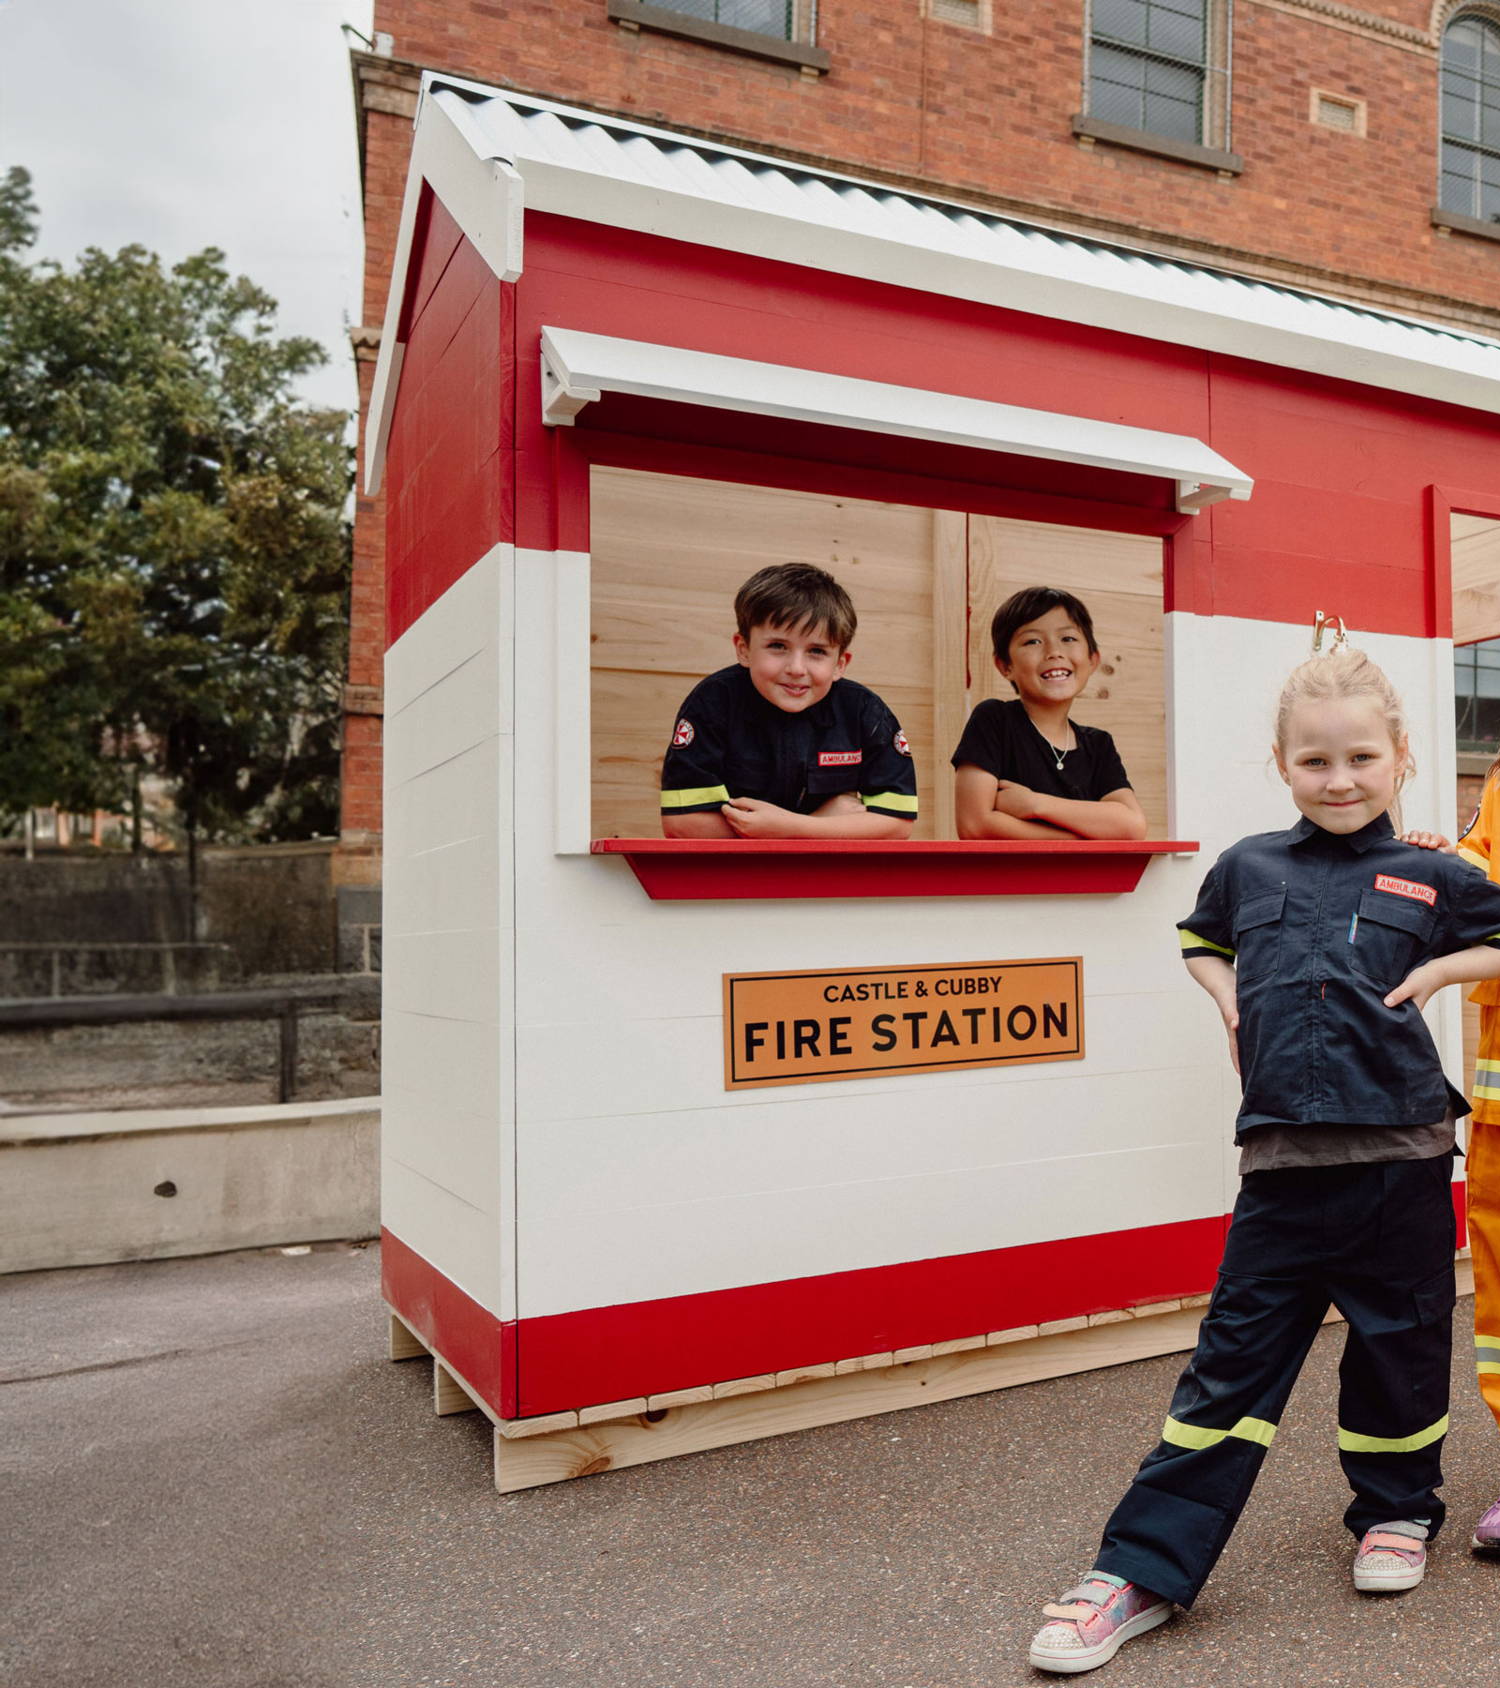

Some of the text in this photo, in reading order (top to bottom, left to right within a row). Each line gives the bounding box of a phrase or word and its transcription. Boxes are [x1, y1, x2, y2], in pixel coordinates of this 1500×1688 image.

[823, 976, 1003, 1003] CASTLE & CUBBY
[745, 1002, 1068, 1062] FIRE STATION
